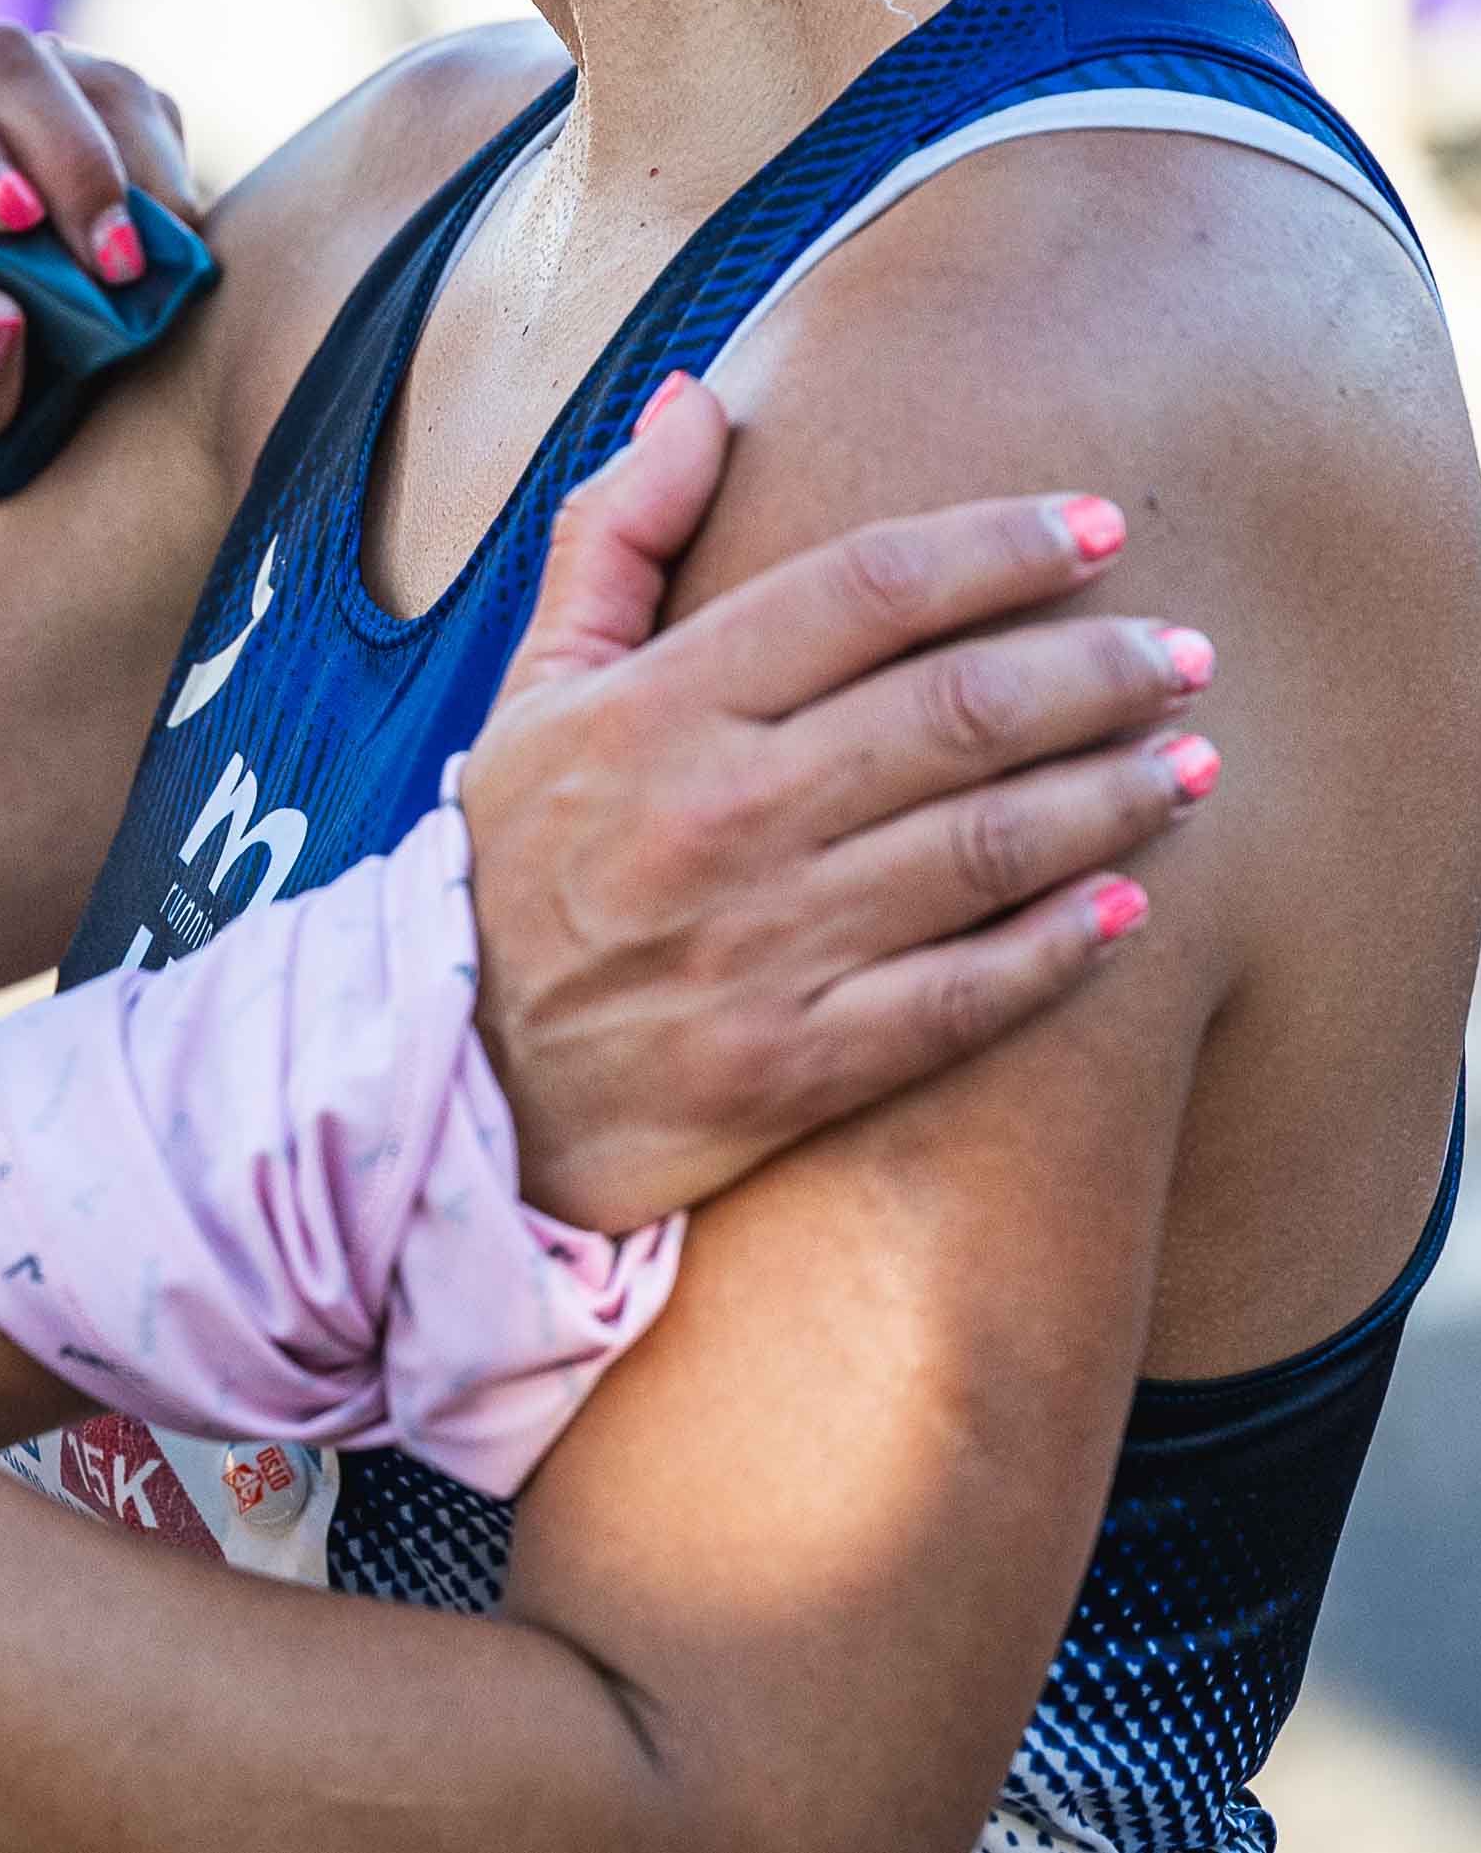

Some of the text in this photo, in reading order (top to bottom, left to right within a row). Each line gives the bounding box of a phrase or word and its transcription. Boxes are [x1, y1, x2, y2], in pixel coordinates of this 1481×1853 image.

[158, 880, 215, 954] runnin
[66, 1429, 164, 1530] 15K
[256, 1446, 295, 1492] OTSO
